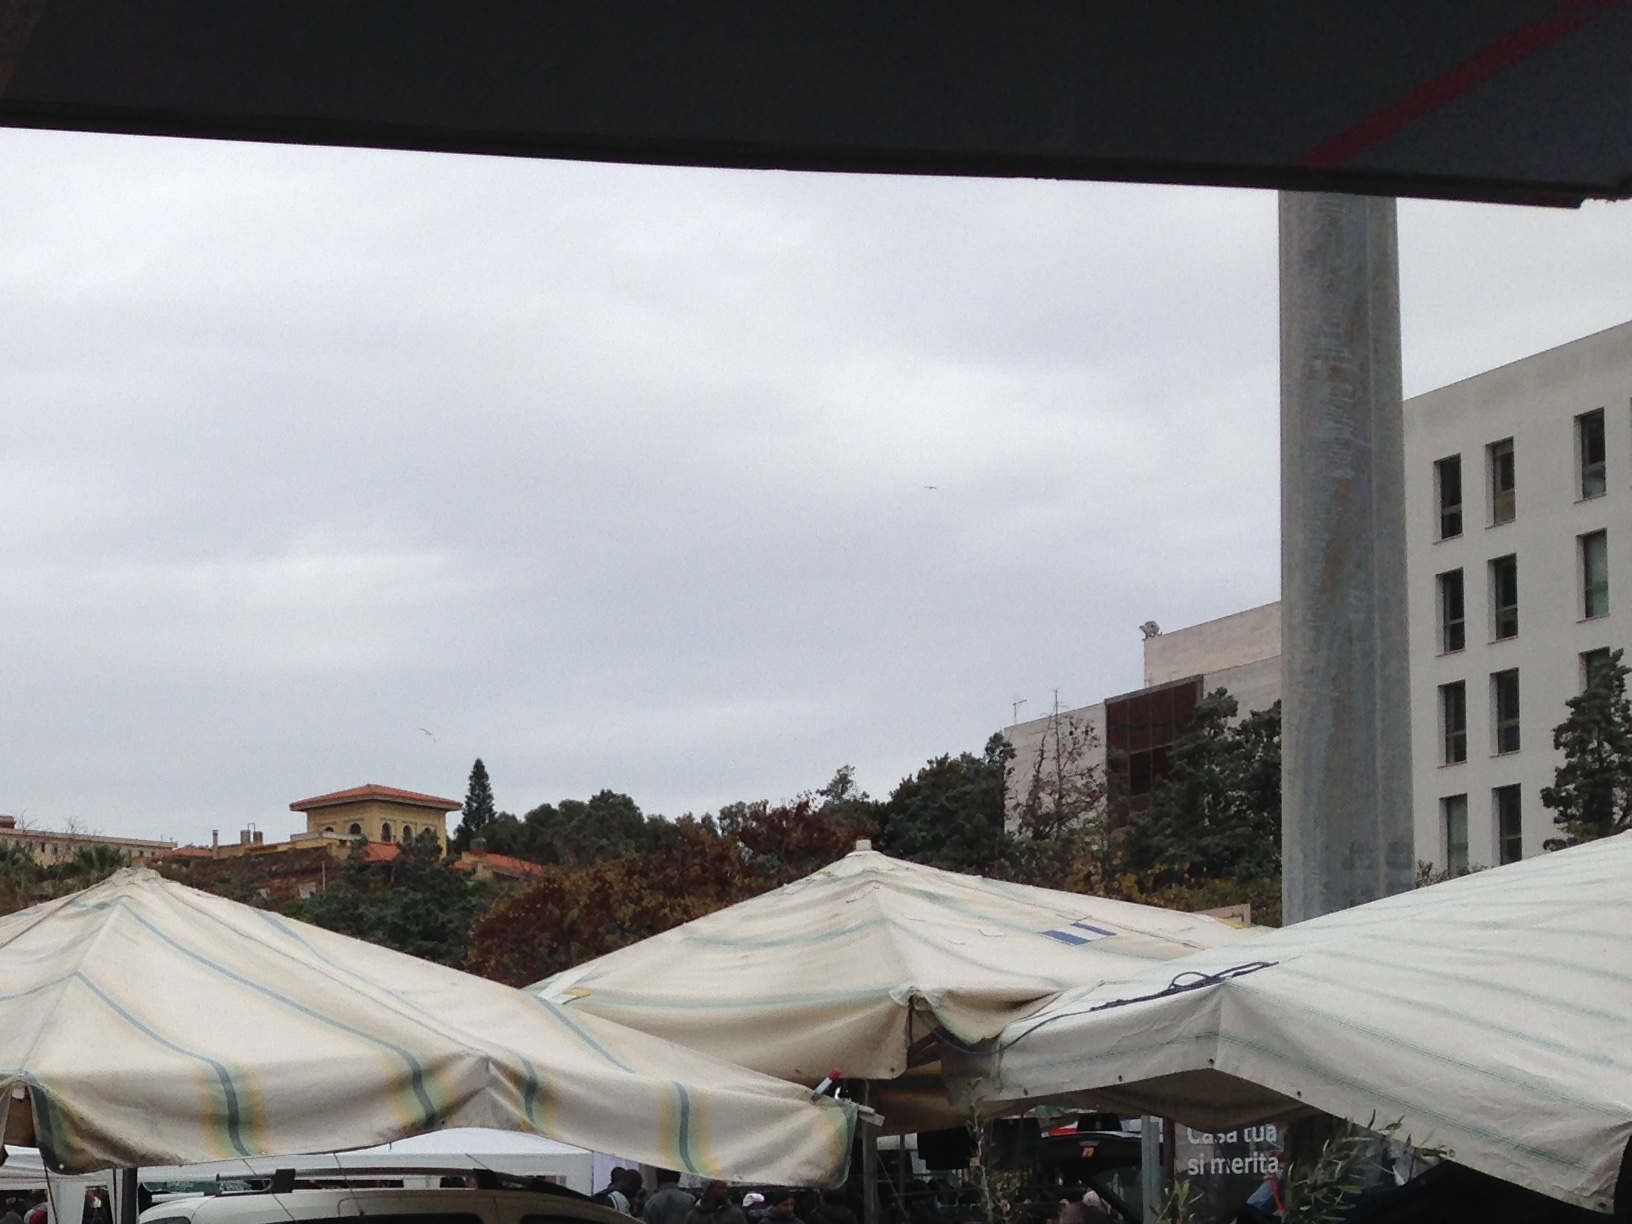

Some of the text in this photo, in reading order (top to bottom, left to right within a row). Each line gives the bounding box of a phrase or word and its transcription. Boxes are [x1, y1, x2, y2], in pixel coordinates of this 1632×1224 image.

[1243, 1123, 1278, 1143] tua
[1187, 1150, 1280, 1176] si merita
